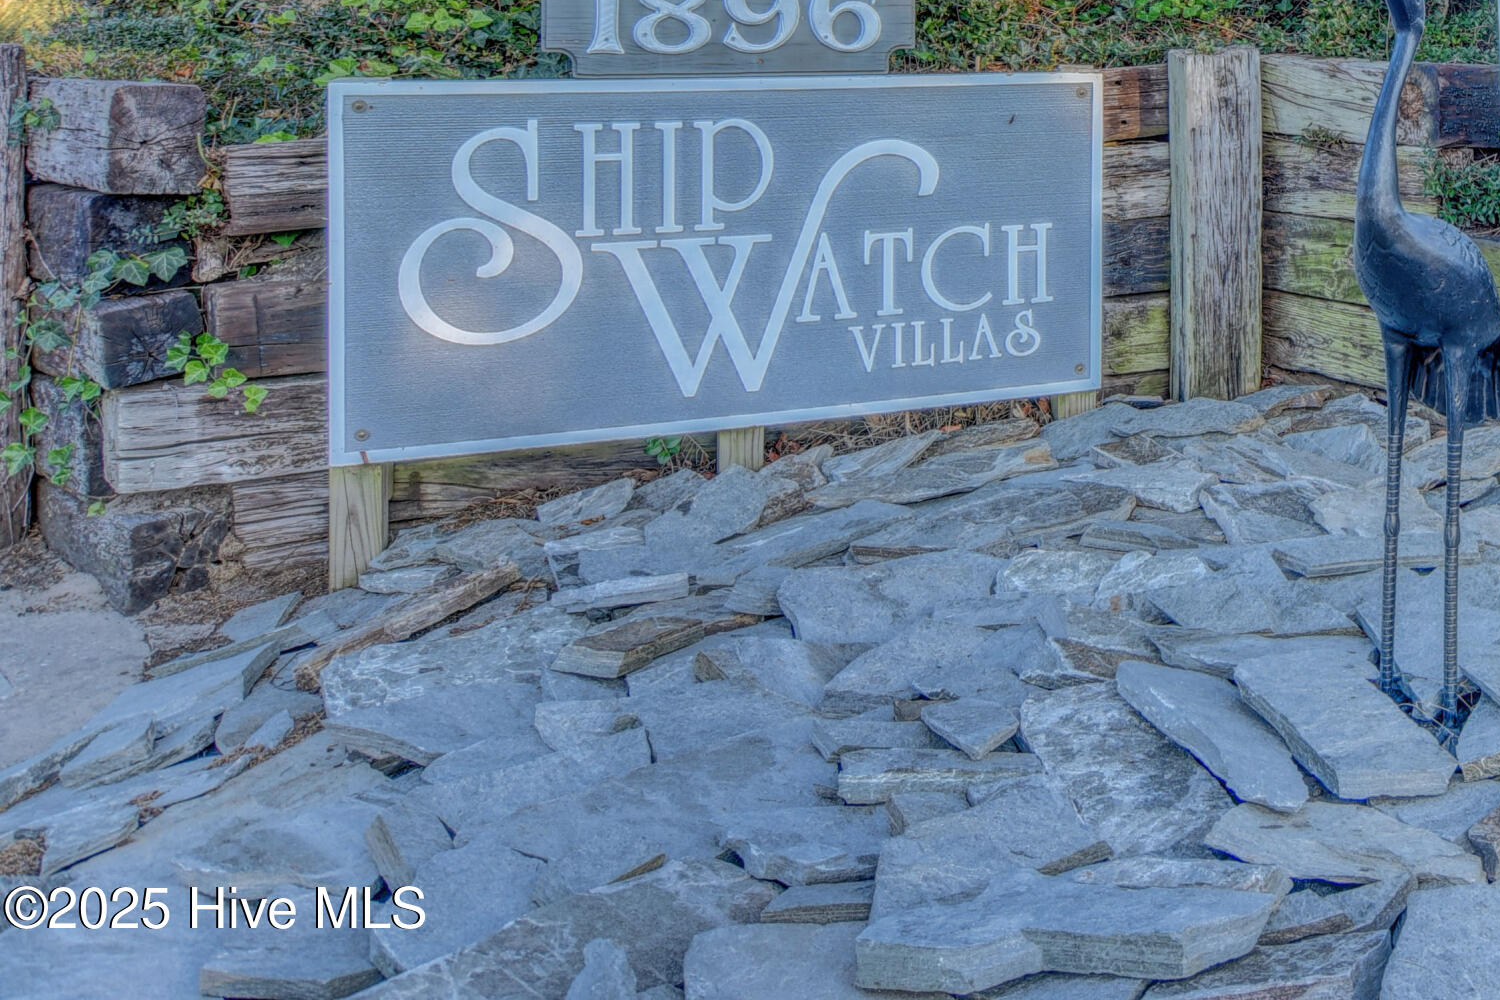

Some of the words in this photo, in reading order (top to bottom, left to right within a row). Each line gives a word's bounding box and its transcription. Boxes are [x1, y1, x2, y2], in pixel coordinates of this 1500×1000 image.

[398, 117, 774, 347] SHIP
[590, 139, 1054, 398] WATCH
[847, 309, 1041, 373] VILLAS
